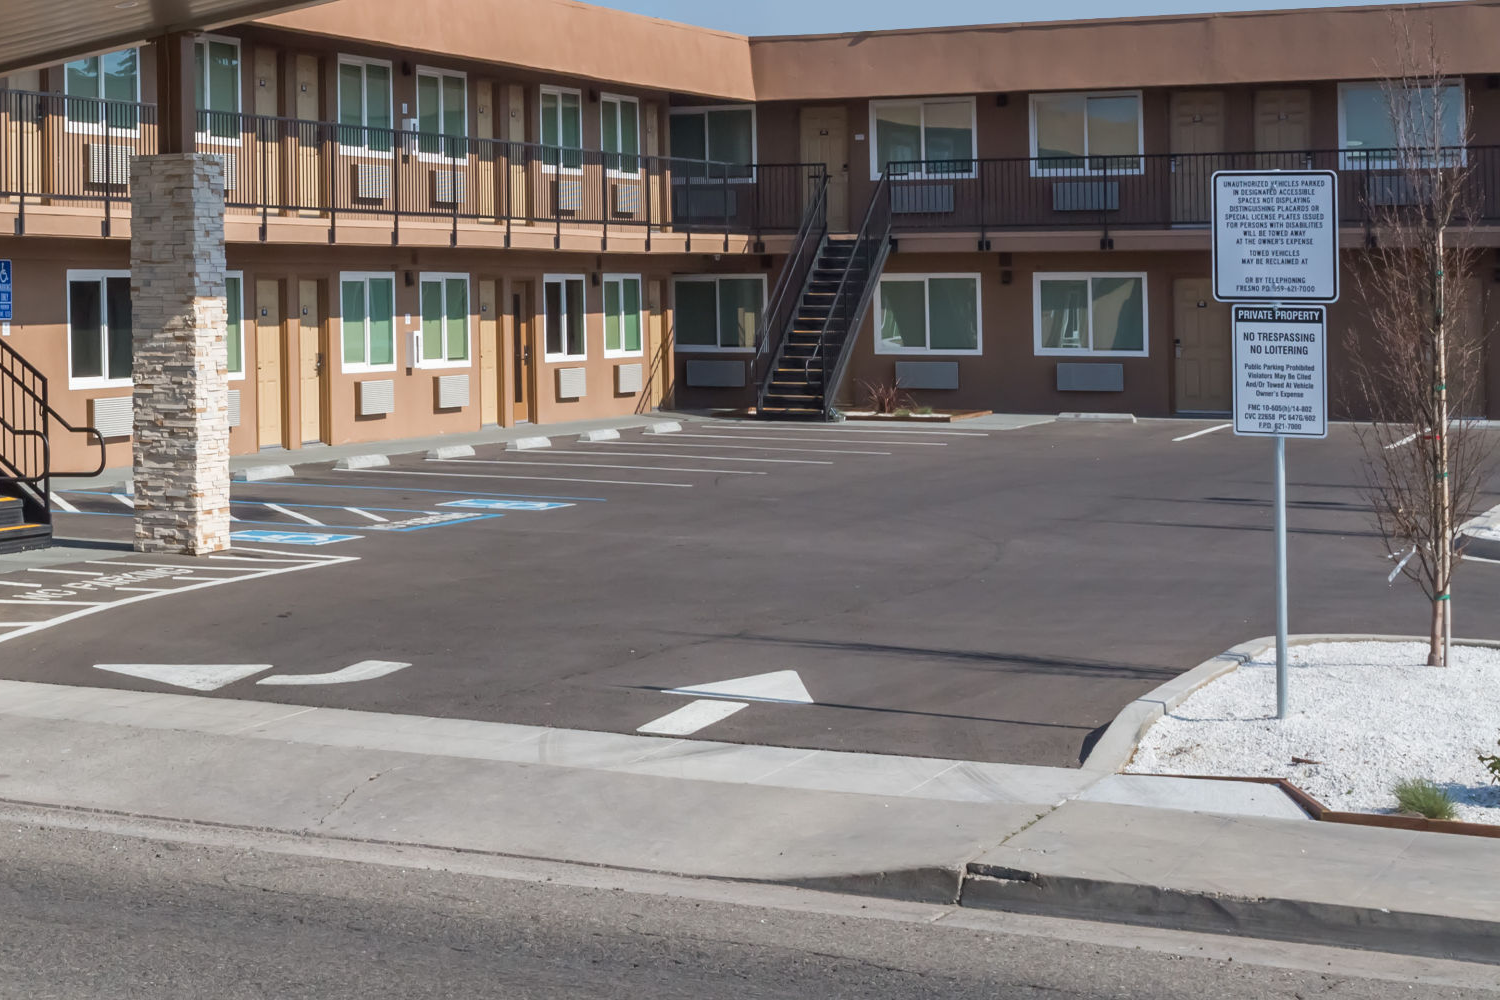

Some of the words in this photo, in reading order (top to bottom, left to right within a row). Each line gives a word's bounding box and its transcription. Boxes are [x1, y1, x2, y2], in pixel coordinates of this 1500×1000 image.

[1238, 310, 1273, 319] PRIVATE
[1275, 310, 1320, 321] PROPERTY
[1243, 332, 1255, 341] NO
[1258, 333, 1315, 343] TRESPASSING
[1250, 345, 1262, 354] NO
[1264, 345, 1309, 355] LOITERING
[1263, 364, 1284, 372] Parking
